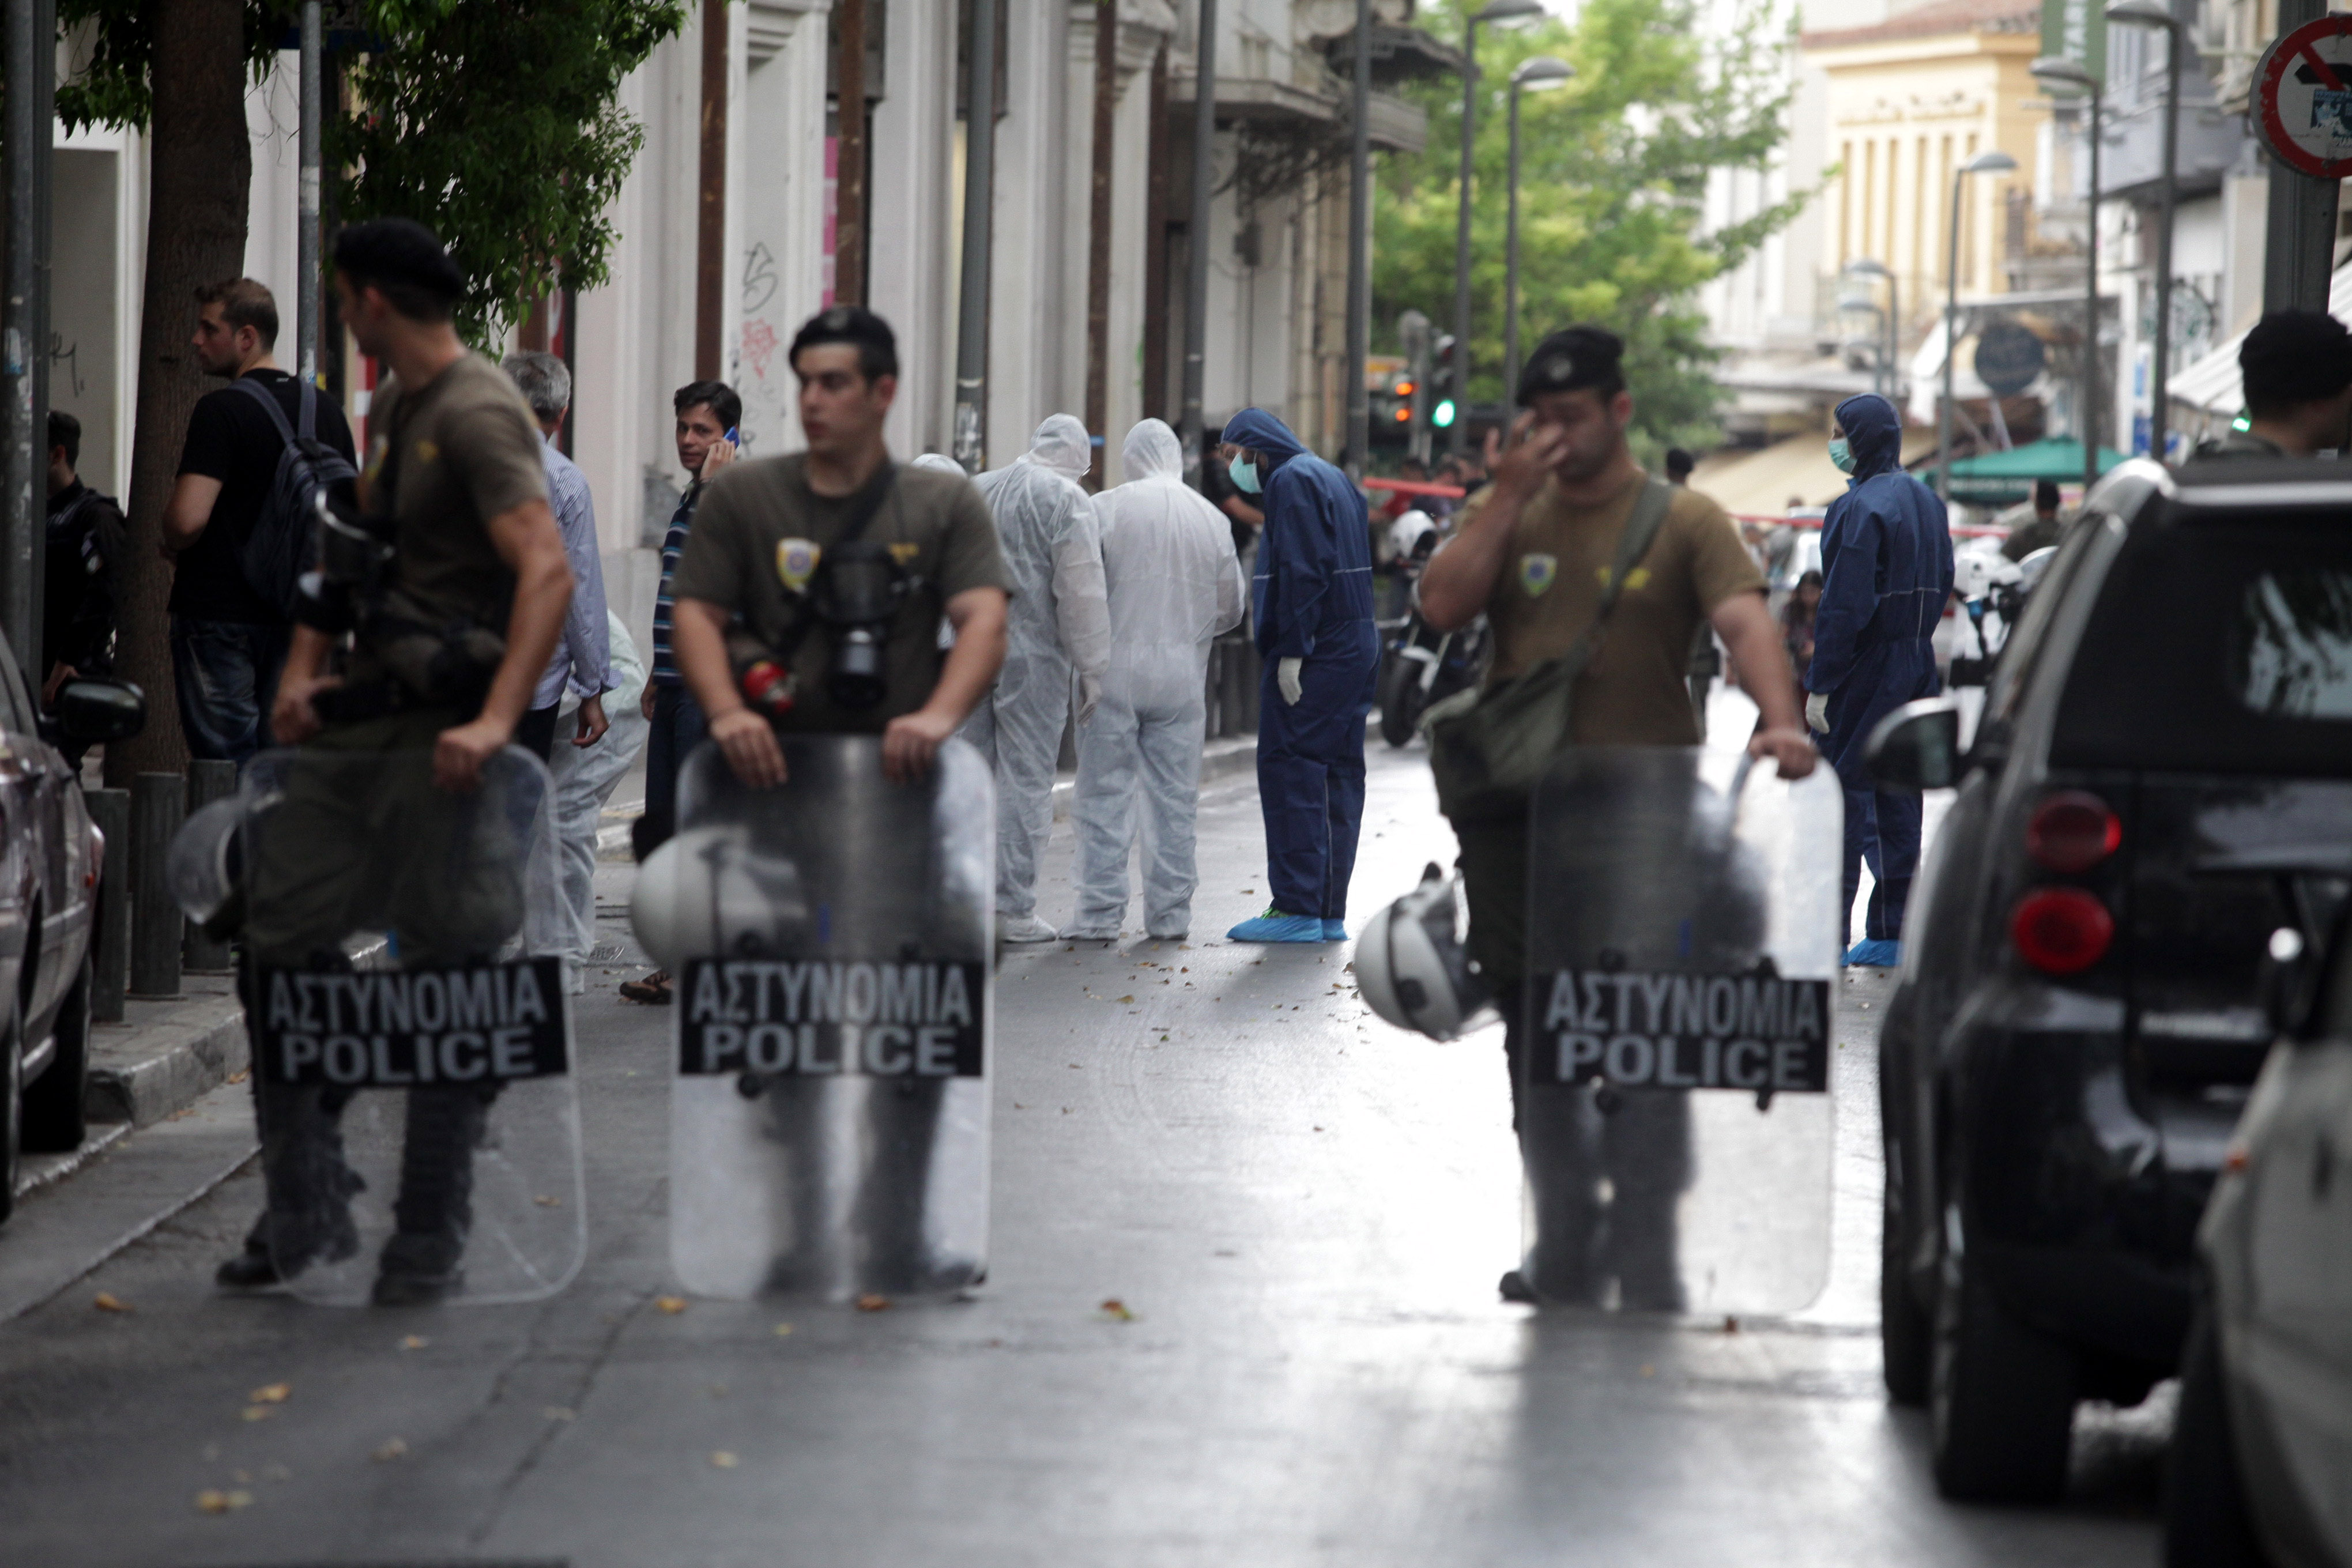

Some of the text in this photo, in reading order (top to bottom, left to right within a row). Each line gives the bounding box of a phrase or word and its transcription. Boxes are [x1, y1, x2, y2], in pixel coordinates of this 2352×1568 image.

[270, 967, 545, 1032] ΑΣΤΥΝΟΜΙΑ
[691, 963, 971, 1024] ΑΣΤΥΝΟΜΙΑ
[1546, 972, 1820, 1038] ΑΣΤΥΝΟΜΙΑ
[284, 1027, 535, 1082] POLICE
[701, 1025, 958, 1076] POLICE
[1556, 1034, 1811, 1090] POLICE
